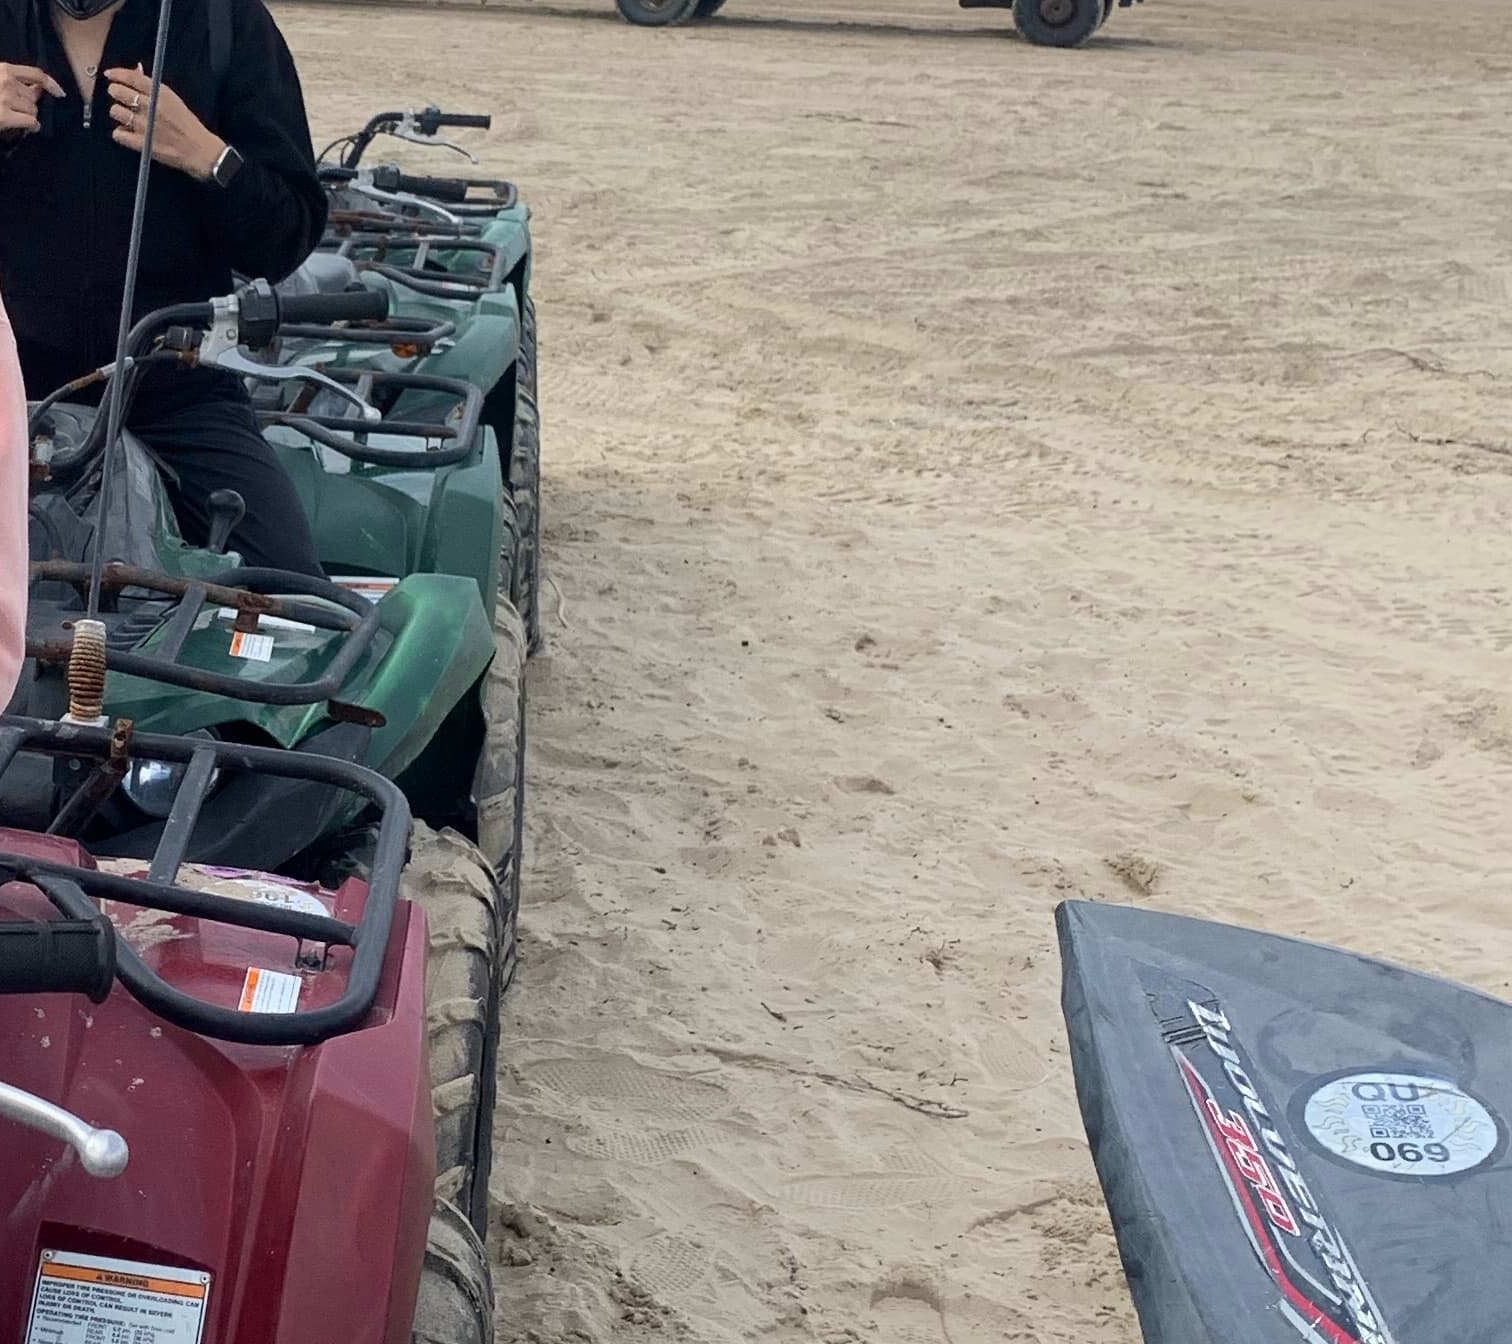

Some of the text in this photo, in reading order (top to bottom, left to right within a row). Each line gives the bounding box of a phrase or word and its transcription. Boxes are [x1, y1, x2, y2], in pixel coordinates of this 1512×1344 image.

[1352, 1083, 1420, 1102] QU
[1370, 1142, 1450, 1162] 069
[1206, 1097, 1301, 1237] 350
